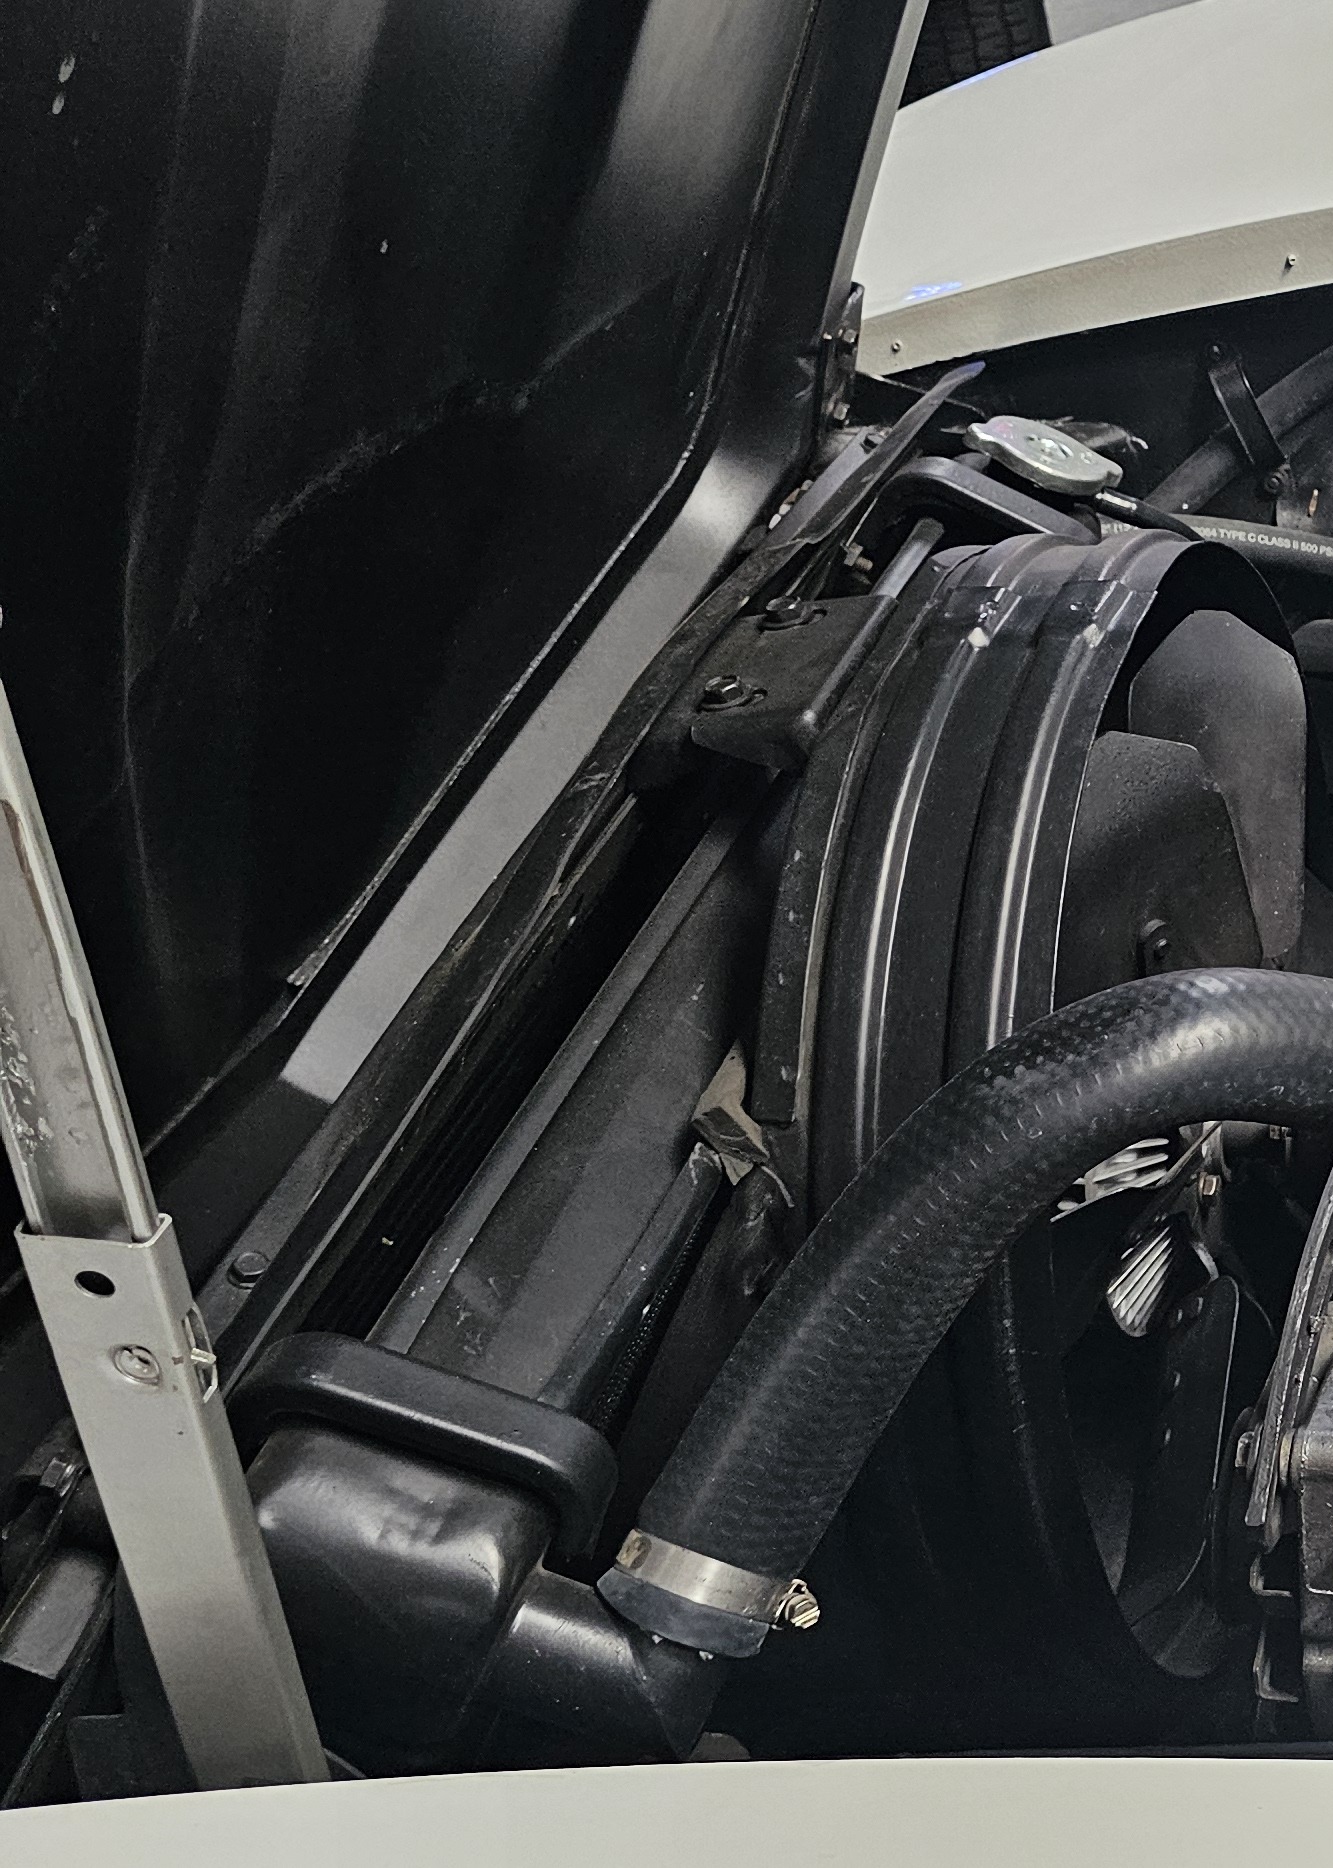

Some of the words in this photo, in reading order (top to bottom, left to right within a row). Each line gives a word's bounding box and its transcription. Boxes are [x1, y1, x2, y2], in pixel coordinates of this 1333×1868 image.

[1218, 528, 1246, 542] TYPE
[1247, 532, 1257, 543] C
[1257, 533, 1291, 549] CLASS
